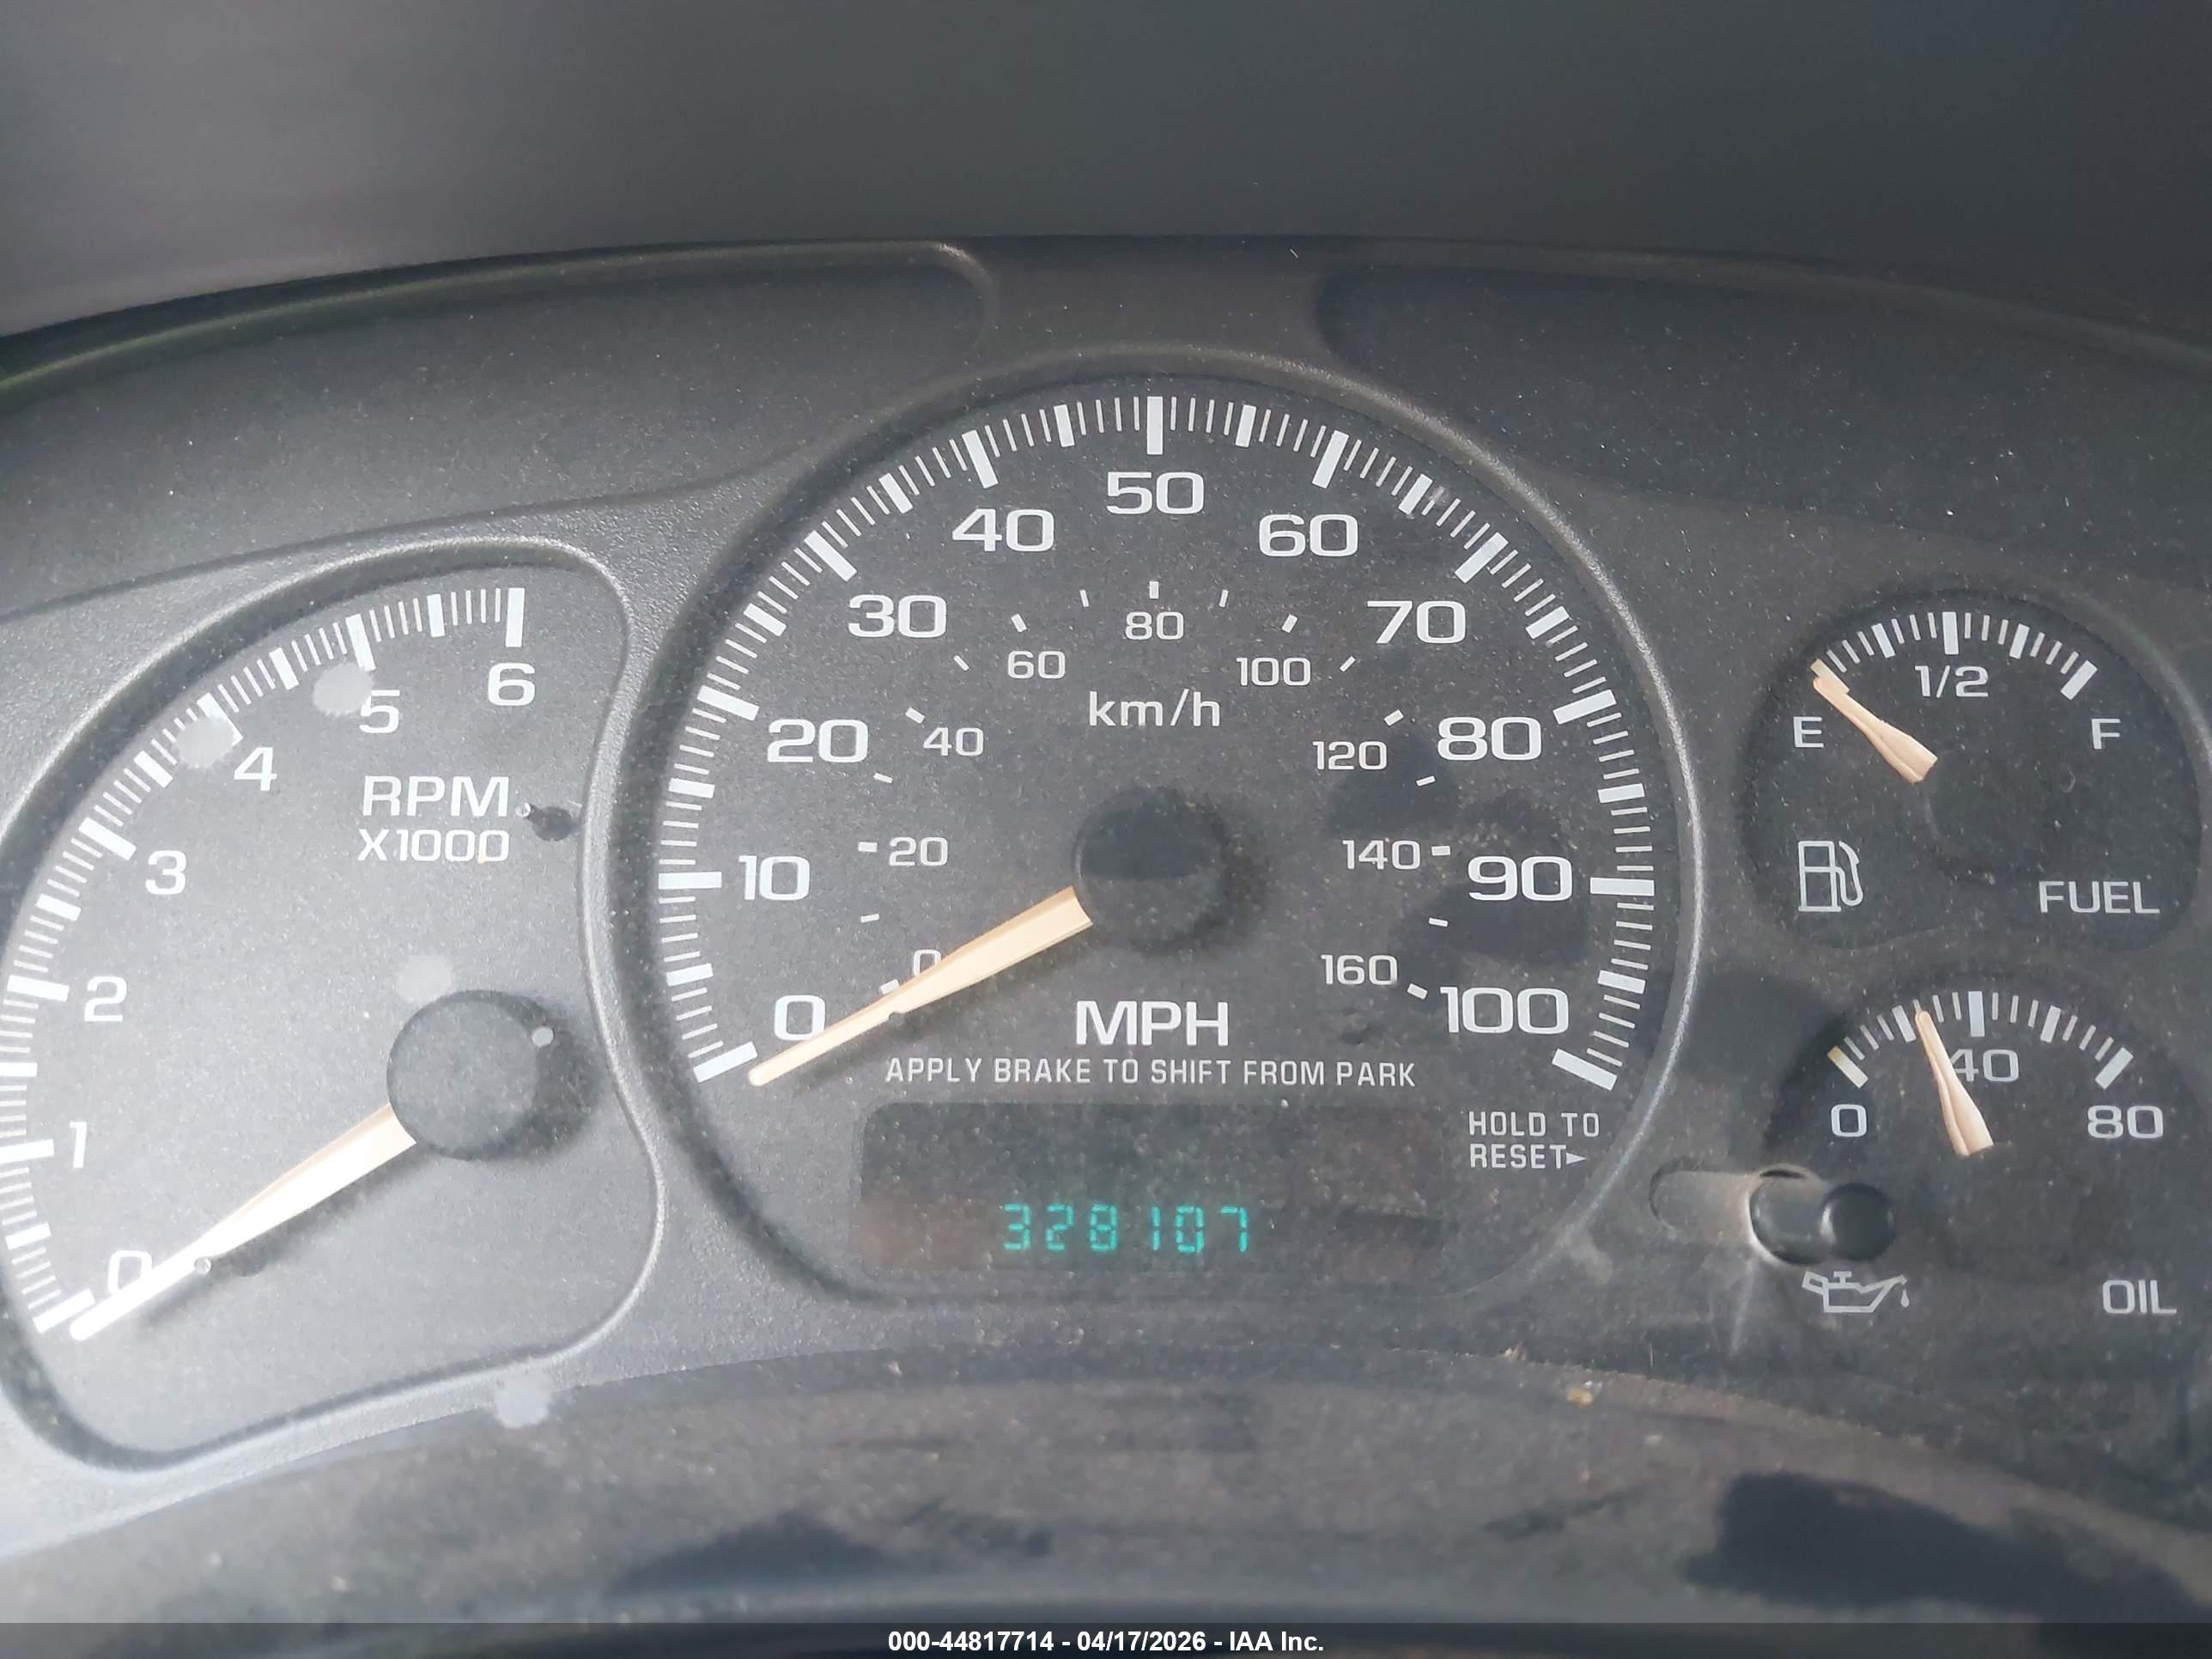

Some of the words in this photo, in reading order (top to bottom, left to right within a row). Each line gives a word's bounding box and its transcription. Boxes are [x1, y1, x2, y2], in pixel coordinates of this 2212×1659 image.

[1106, 471, 1205, 514] 50
[951, 508, 1055, 552] 40
[1258, 514, 1359, 557] 60
[848, 594, 947, 638] 30
[1125, 611, 1184, 641] 80
[1367, 599, 1467, 645] 70
[1007, 650, 1066, 679] 60
[1236, 657, 1311, 686] 100
[1914, 665, 1990, 699] 1/2
[487, 663, 536, 707] 6
[358, 689, 402, 733] 5
[1089, 689, 1221, 726] km/h
[767, 719, 869, 763] 20
[923, 727, 984, 757] 40
[1437, 716, 1542, 761] 80
[1792, 715, 1825, 749] E
[2091, 718, 2121, 750] F
[234, 747, 277, 792] 4
[1311, 740, 1388, 770] 120
[362, 775, 509, 817] RPM
[357, 830, 509, 862] X1000
[889, 836, 949, 866] 20
[1341, 839, 1421, 871] 140
[145, 850, 187, 895] 3
[738, 855, 811, 901] 10
[1467, 855, 1574, 902] 90
[2038, 880, 2160, 915] FUEL
[1321, 954, 1399, 986] 160
[85, 975, 127, 1022] 2
[774, 994, 826, 1042] 0
[1439, 987, 1571, 1034] 100
[1075, 1000, 1230, 1047] MPH
[885, 1057, 983, 1083] APPLY
[994, 1058, 1091, 1084] BRAKE
[1102, 1059, 1140, 1084] TO
[1151, 1060, 1231, 1085] SHIFT
[1243, 1060, 1326, 1086] FROM
[1336, 1061, 1417, 1087] PARK
[1949, 1048, 2021, 1084] 40
[1468, 1111, 1546, 1138] HOLD
[1561, 1112, 1601, 1138] TO
[1830, 1103, 1869, 1138] 0
[2087, 1105, 2164, 1139] 80
[69, 1121, 87, 1168] 1
[1469, 1143, 1567, 1170] RESET
[1003, 1203, 1250, 1254] 328107
[107, 1250, 153, 1297] 0
[2102, 1279, 2178, 1315] OIL
